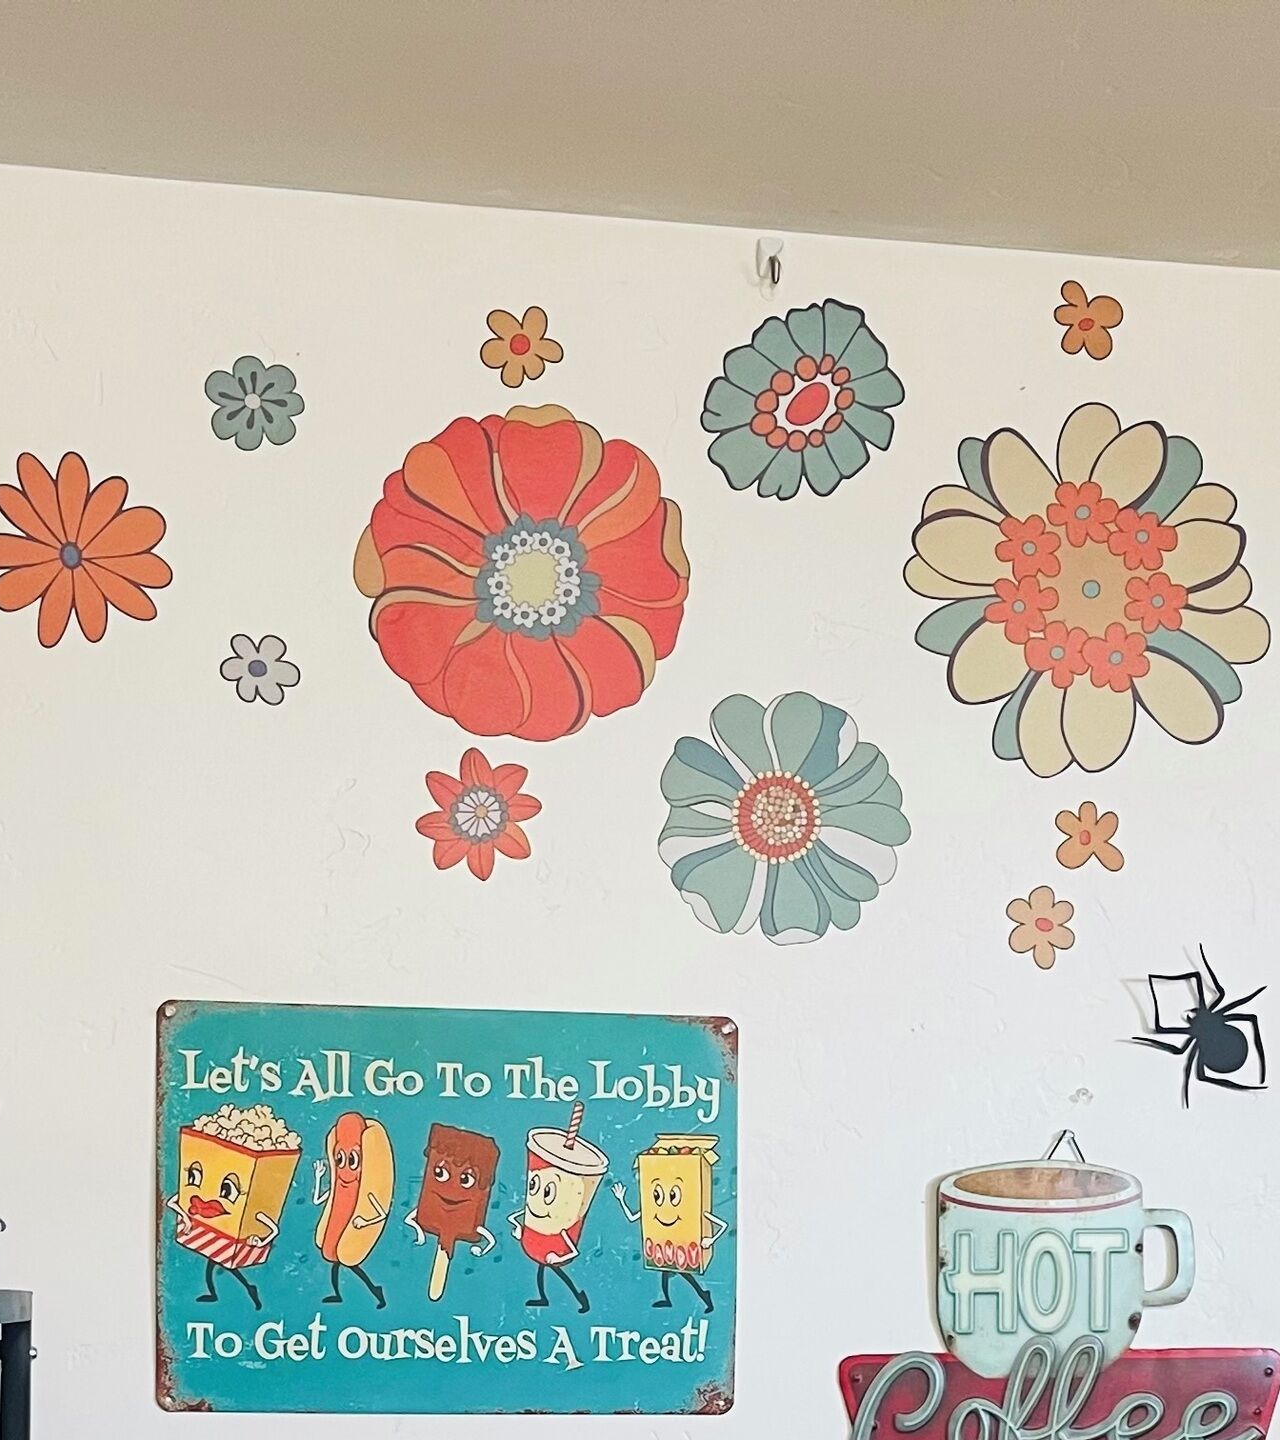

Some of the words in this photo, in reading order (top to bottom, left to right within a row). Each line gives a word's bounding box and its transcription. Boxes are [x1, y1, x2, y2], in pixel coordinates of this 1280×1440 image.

[179, 1047, 282, 1093] Let's
[288, 1050, 351, 1102] All
[365, 1060, 422, 1096] Go
[435, 1062, 491, 1098] To
[504, 1057, 579, 1101] The
[587, 1060, 720, 1123] Lobby
[644, 1238, 701, 1267] CANDY
[944, 1228, 1129, 1334] HOT
[187, 1321, 243, 1359] To
[255, 1312, 327, 1359] Get
[338, 1315, 537, 1363] Ourselves
[544, 1327, 583, 1370] A
[590, 1319, 708, 1363] Treat!
